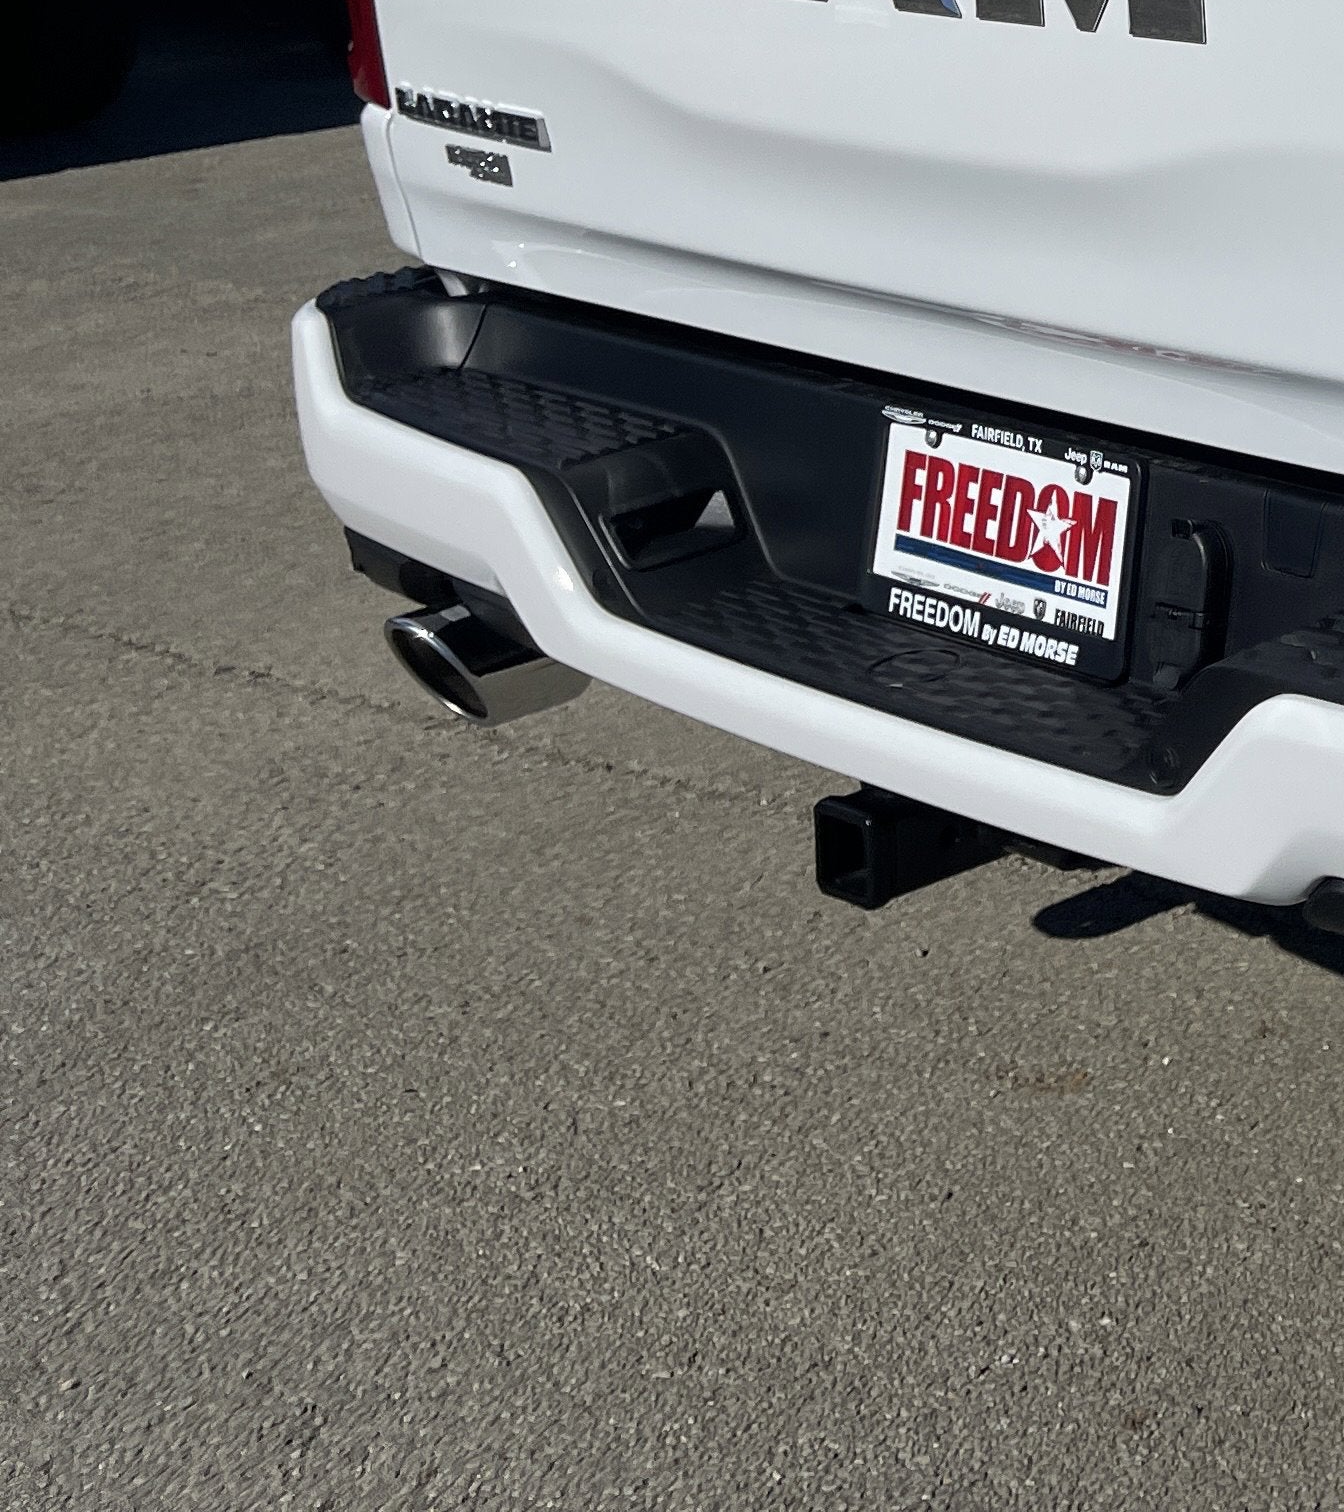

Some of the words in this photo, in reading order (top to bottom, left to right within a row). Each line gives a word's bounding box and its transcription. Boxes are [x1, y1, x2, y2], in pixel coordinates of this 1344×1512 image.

[971, 424, 1025, 450] FAIRFIELD,
[1027, 437, 1043, 454] TX
[1064, 447, 1087, 465] Jeep
[1103, 460, 1128, 474] RAM
[896, 449, 1118, 587] FREEDOM
[994, 592, 1026, 615] Jeep
[1066, 582, 1077, 597] ED
[1078, 585, 1106, 605] MORSE
[888, 587, 981, 639] FREEDOM
[997, 625, 1019, 649] ED
[1019, 631, 1080, 666] MORSE
